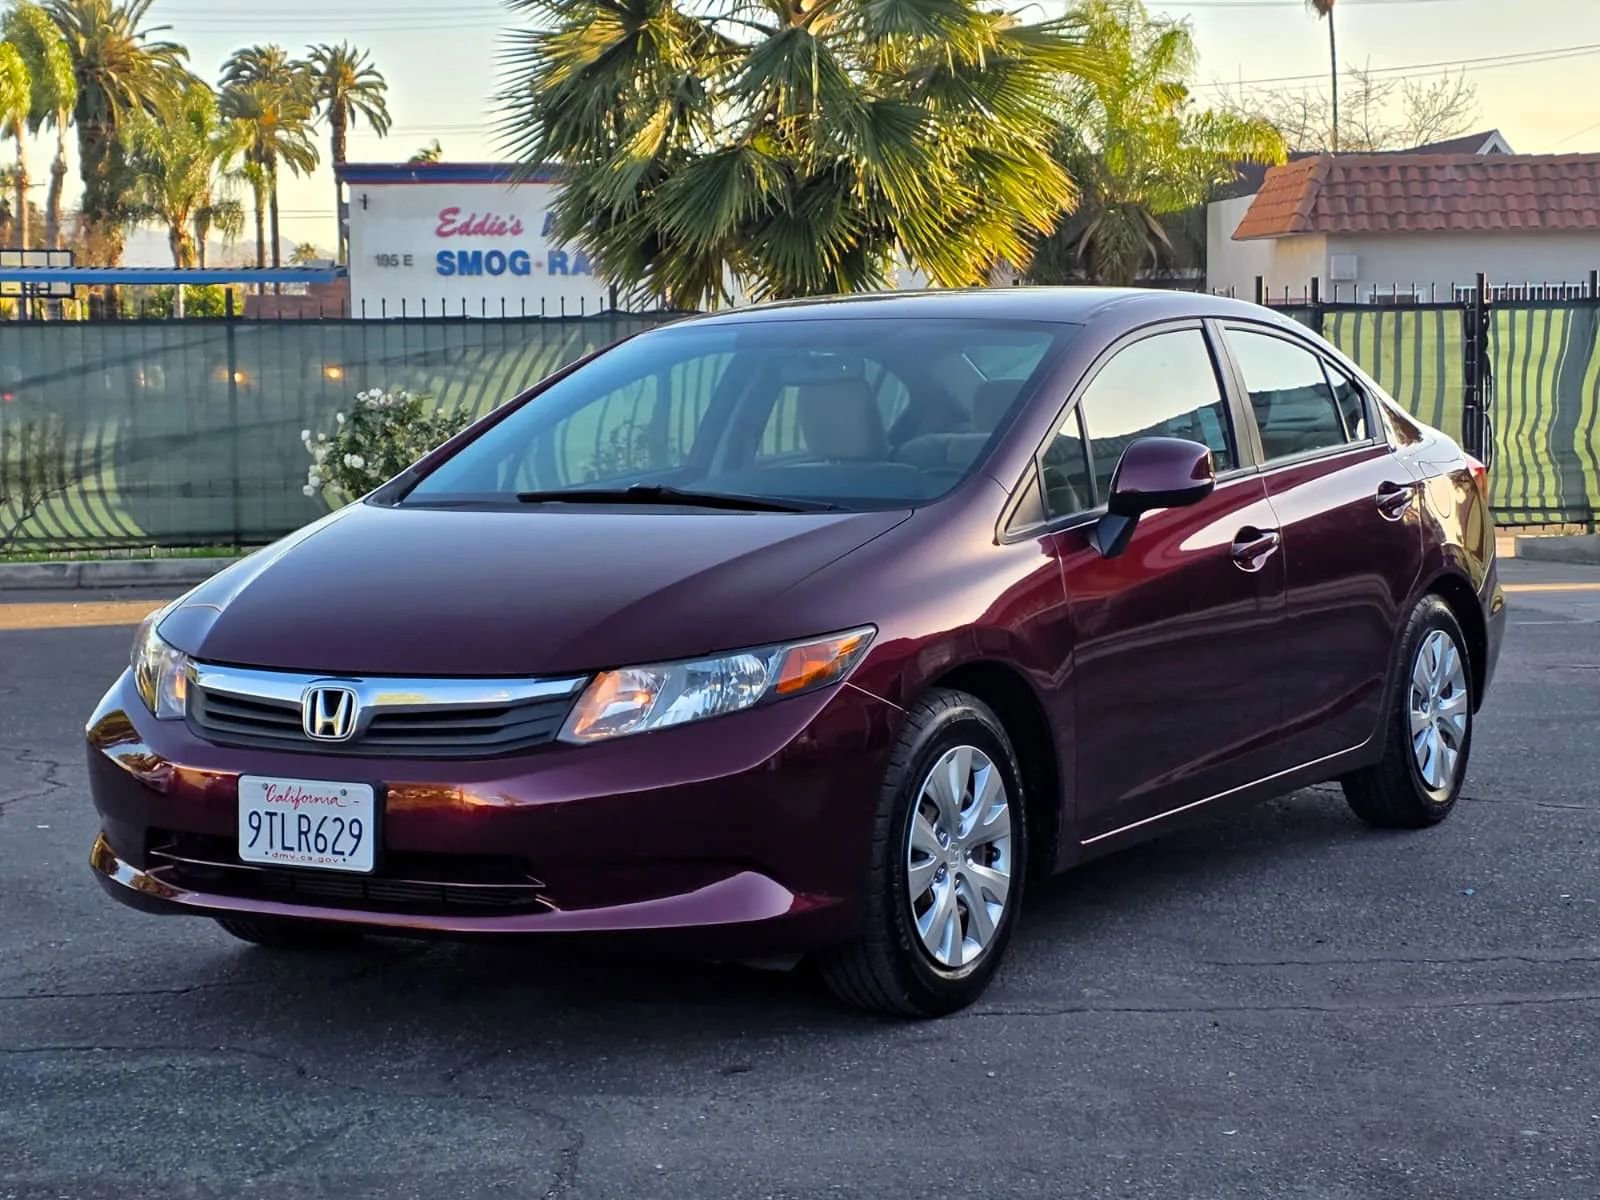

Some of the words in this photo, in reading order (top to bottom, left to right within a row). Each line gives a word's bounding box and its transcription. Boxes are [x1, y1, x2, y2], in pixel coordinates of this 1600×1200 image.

[435, 206, 524, 238] Eddie's
[403, 253, 413, 267] E
[436, 250, 531, 277] SMOG
[266, 783, 347, 810] California
[248, 810, 363, 857] 9TLR629
[271, 851, 340, 864] dmv.ca.gov
